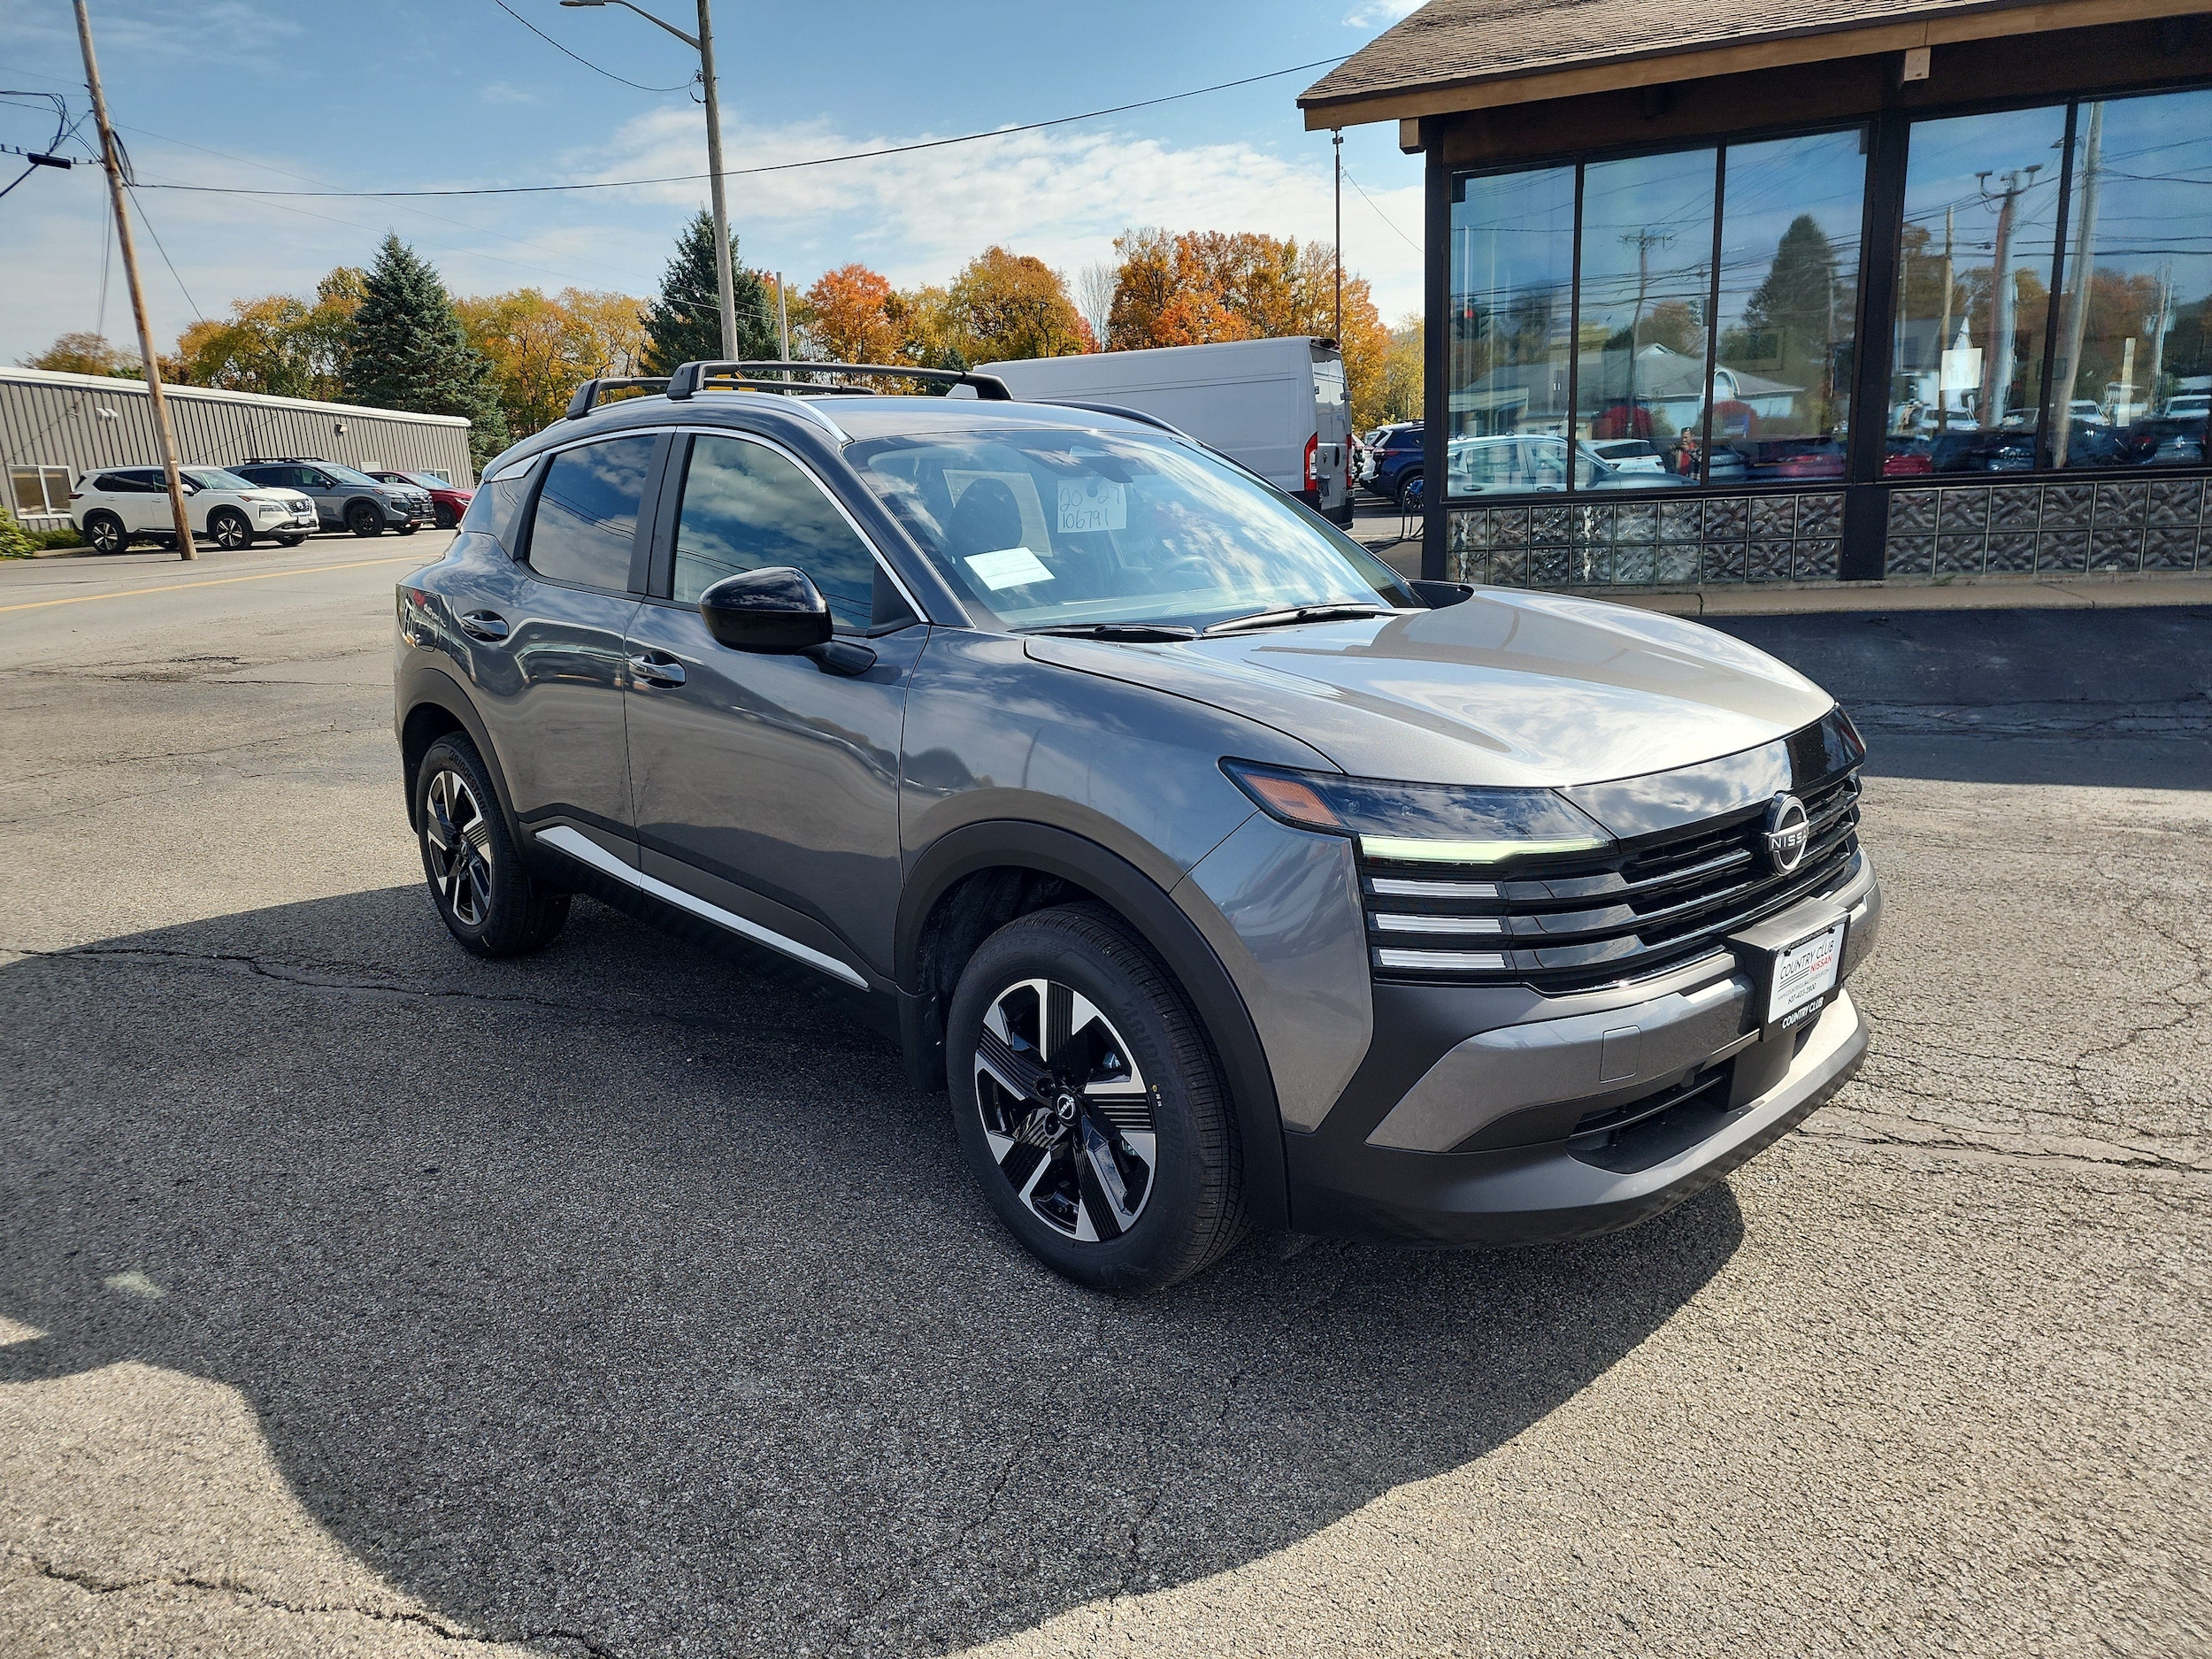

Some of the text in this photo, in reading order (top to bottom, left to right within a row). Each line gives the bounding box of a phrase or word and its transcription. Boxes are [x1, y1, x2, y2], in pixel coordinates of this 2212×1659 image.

[1062, 508, 1109, 529] 106791
[1779, 940, 1835, 979] COUNTRY CLUB
[1809, 955, 1833, 974] NISSAN
[1781, 996, 1824, 1030] COUNTRY CLUB
